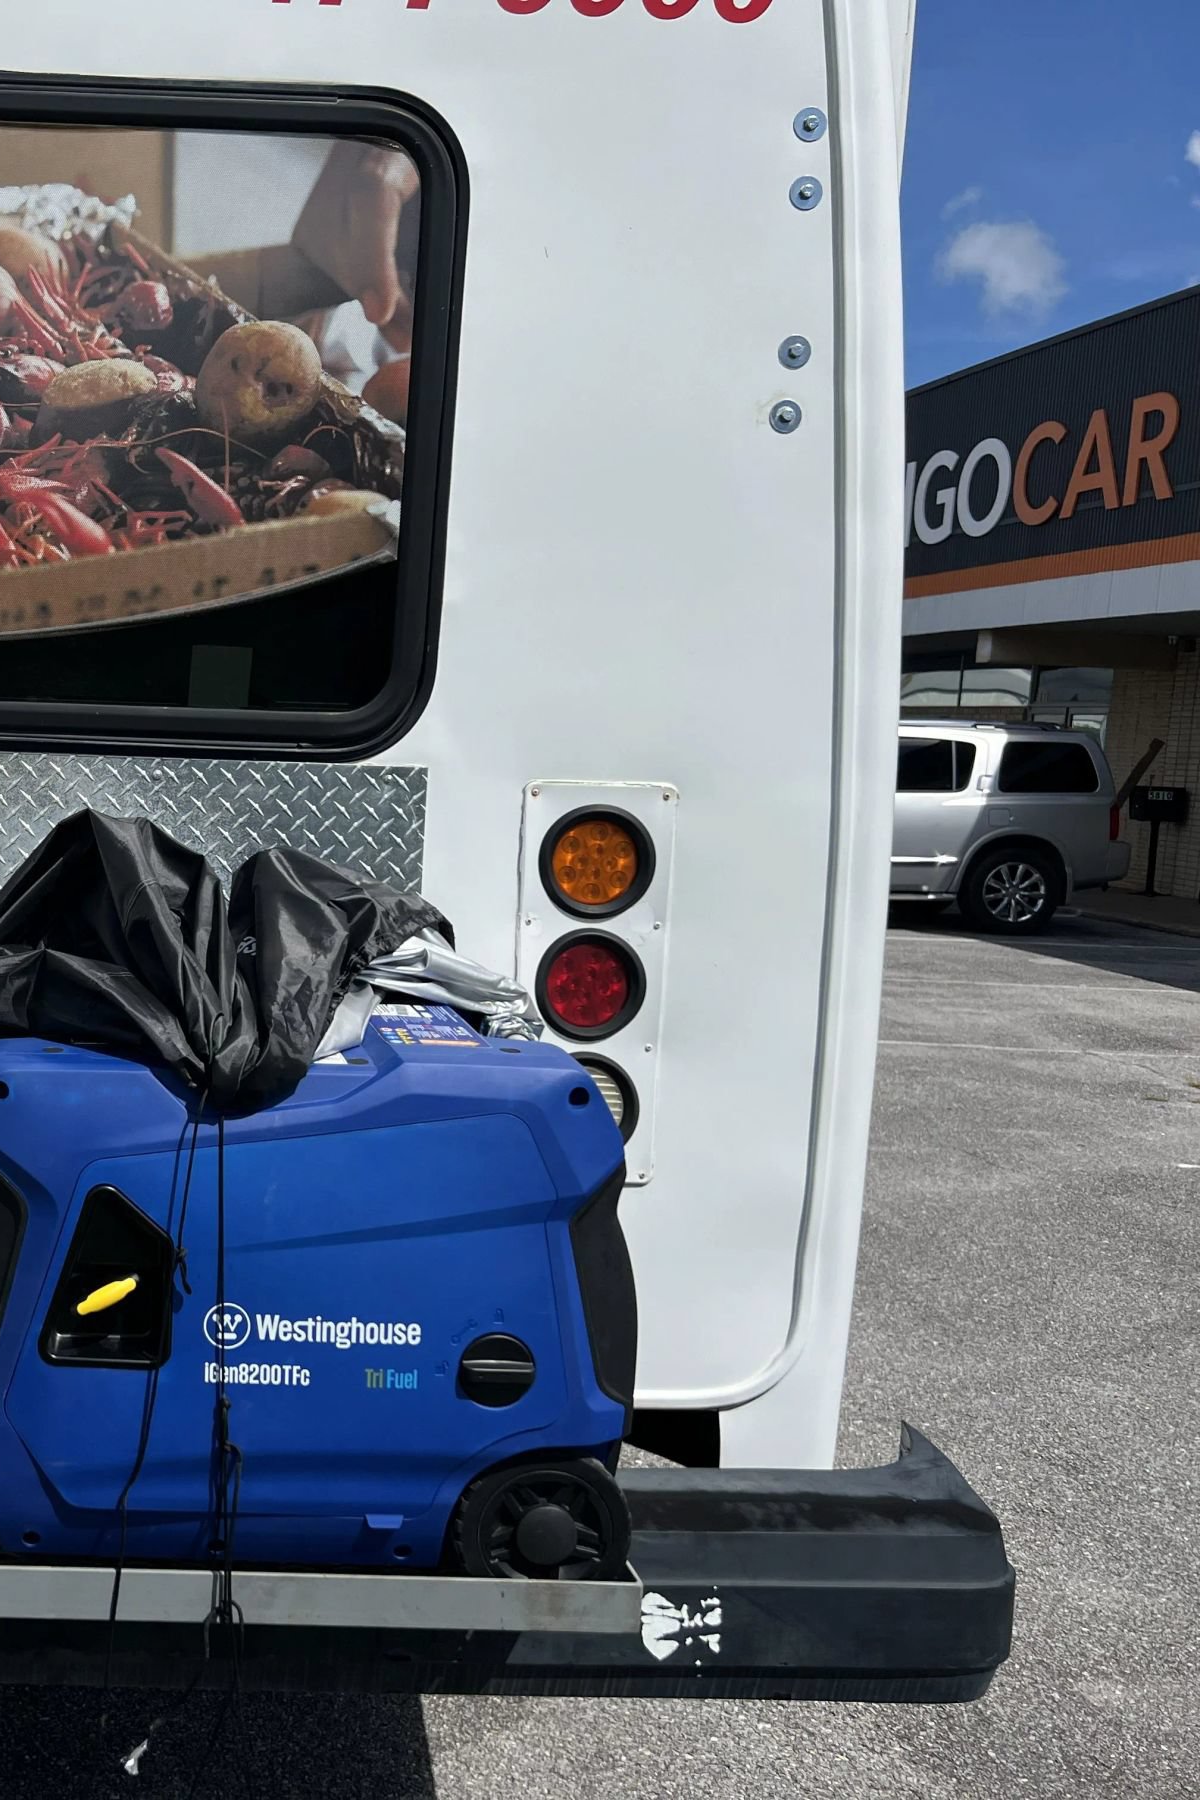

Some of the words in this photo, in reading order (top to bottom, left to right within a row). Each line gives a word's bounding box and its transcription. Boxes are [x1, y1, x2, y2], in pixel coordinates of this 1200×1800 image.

[256, 1314, 422, 1349] Westinghouse
[204, 1361, 311, 1387] iGen8200TFc
[386, 1369, 418, 1390] Fuel
